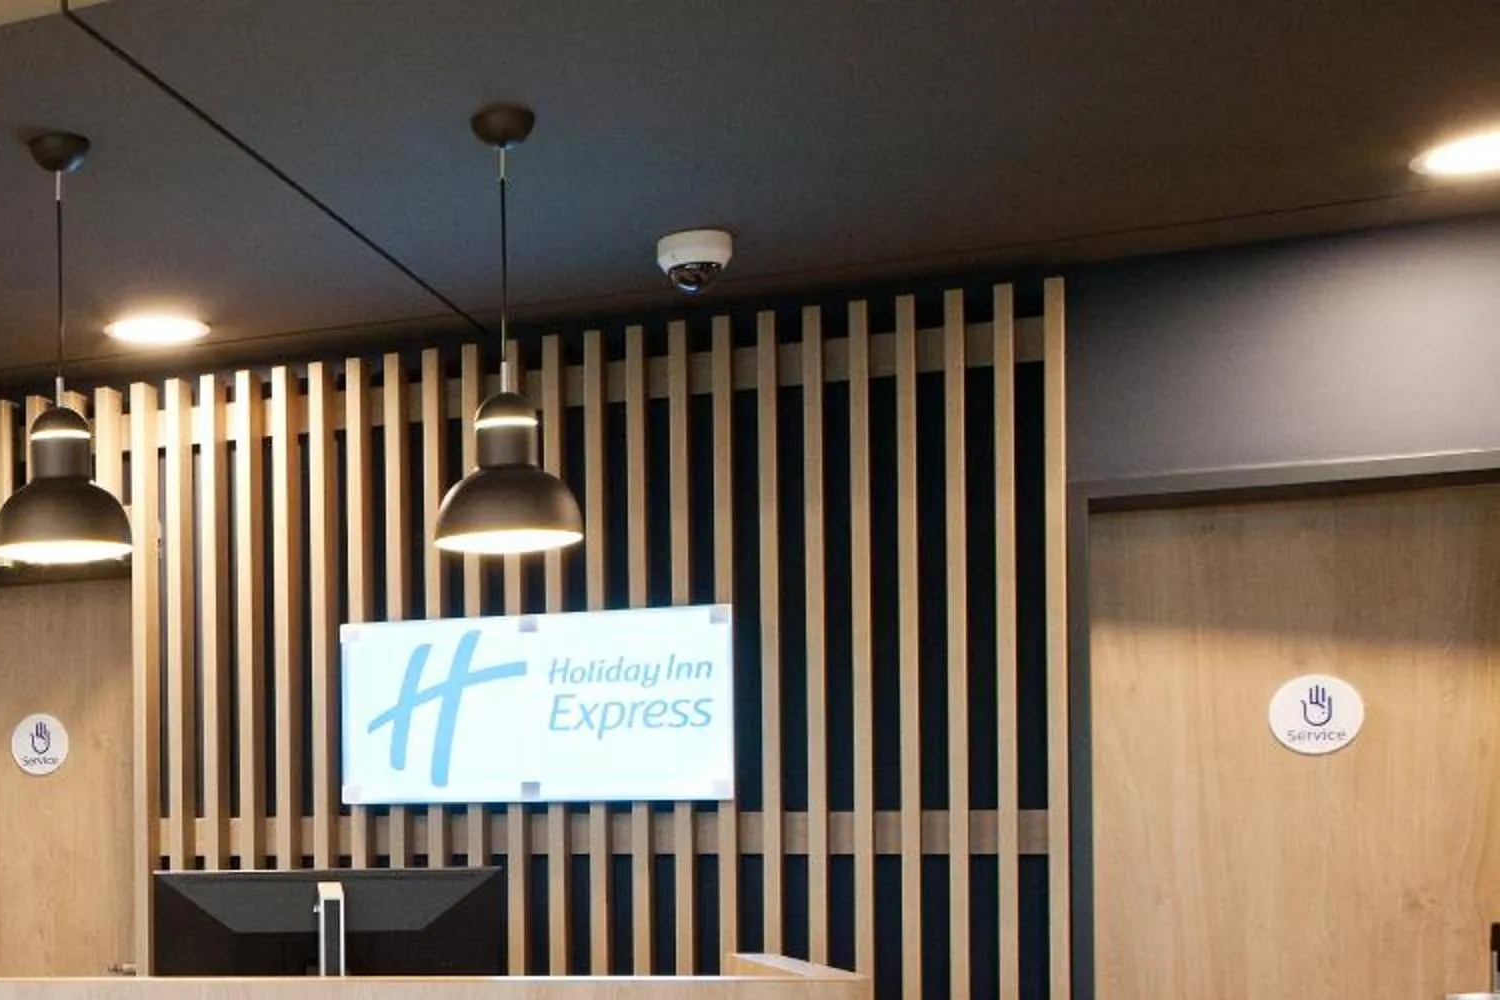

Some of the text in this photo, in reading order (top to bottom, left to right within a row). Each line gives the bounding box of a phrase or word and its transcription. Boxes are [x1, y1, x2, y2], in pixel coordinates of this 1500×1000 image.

[548, 653, 713, 689] Holiday Inn
[548, 693, 714, 741] Express
[1286, 729, 1347, 741] Service
